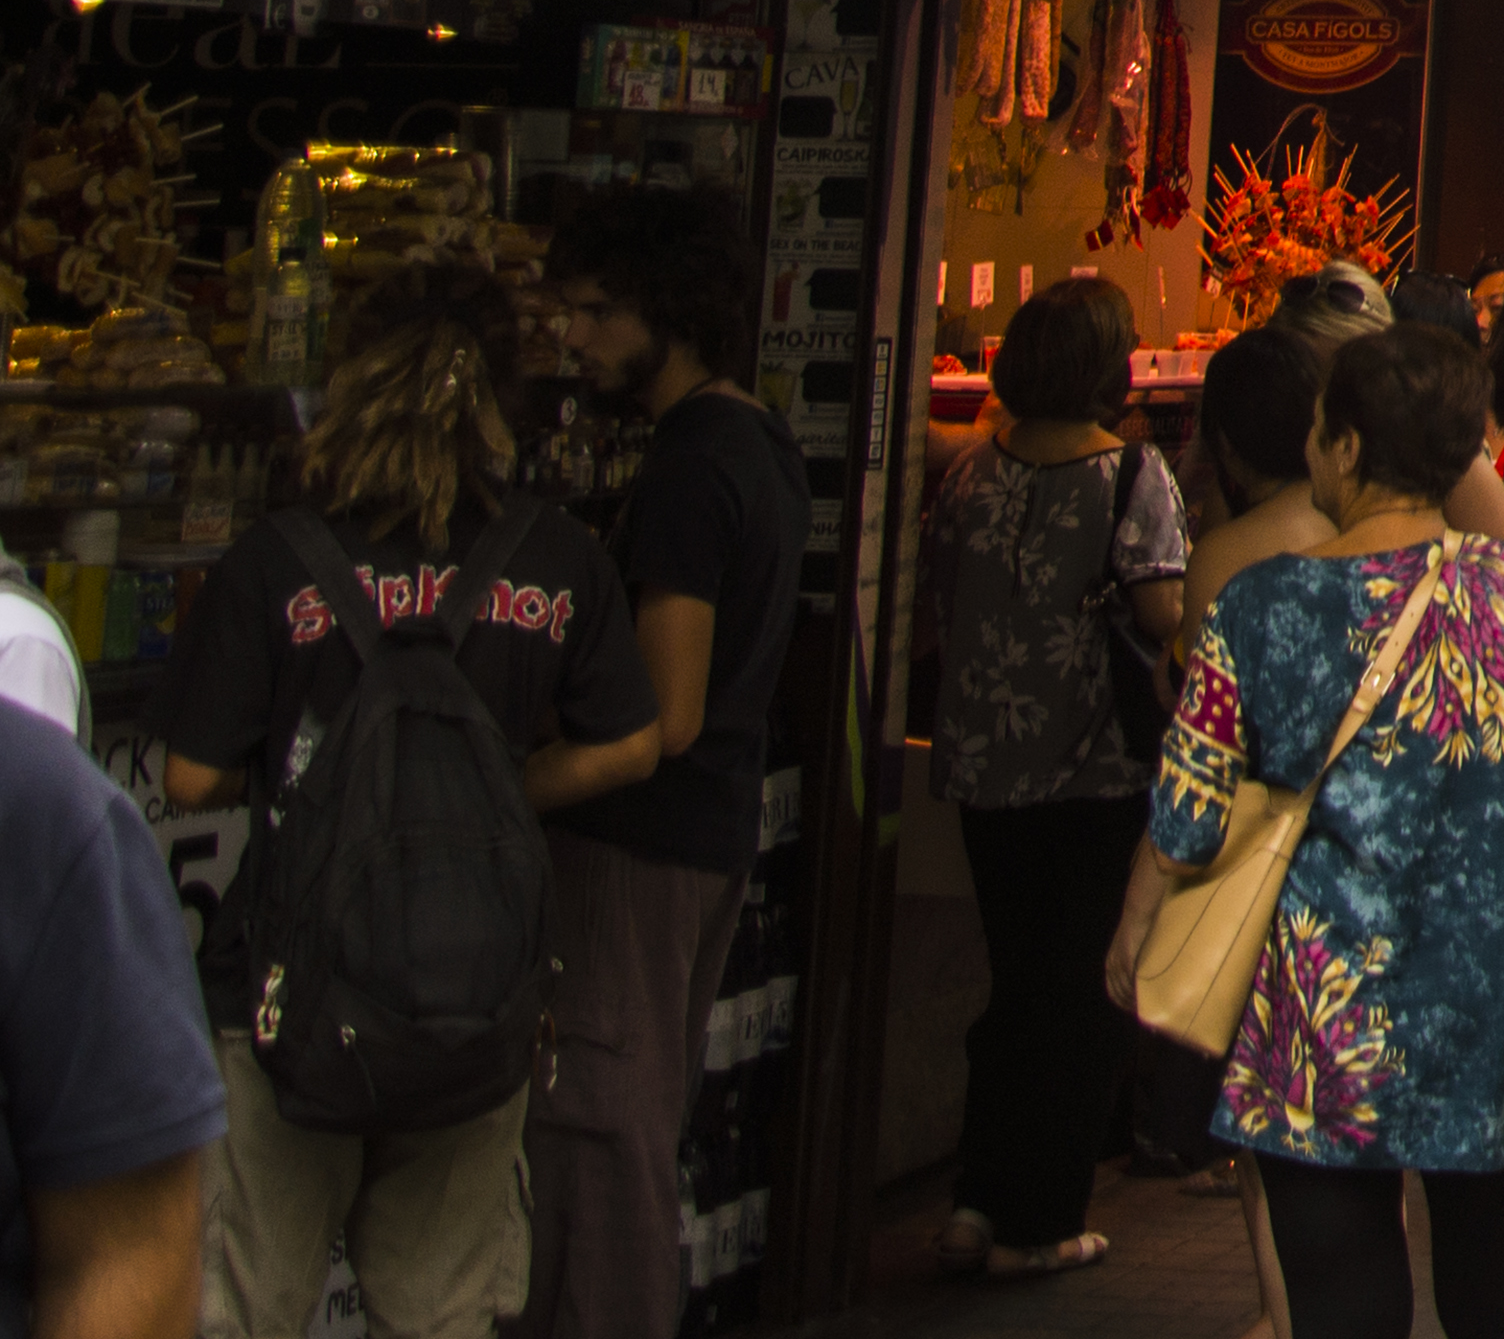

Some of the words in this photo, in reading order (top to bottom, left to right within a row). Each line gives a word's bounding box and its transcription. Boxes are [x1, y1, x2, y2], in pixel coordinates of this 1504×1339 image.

[1251, 20, 1310, 39] CASA
[784, 55, 860, 91] CAVA
[832, 240, 862, 253] BEAC
